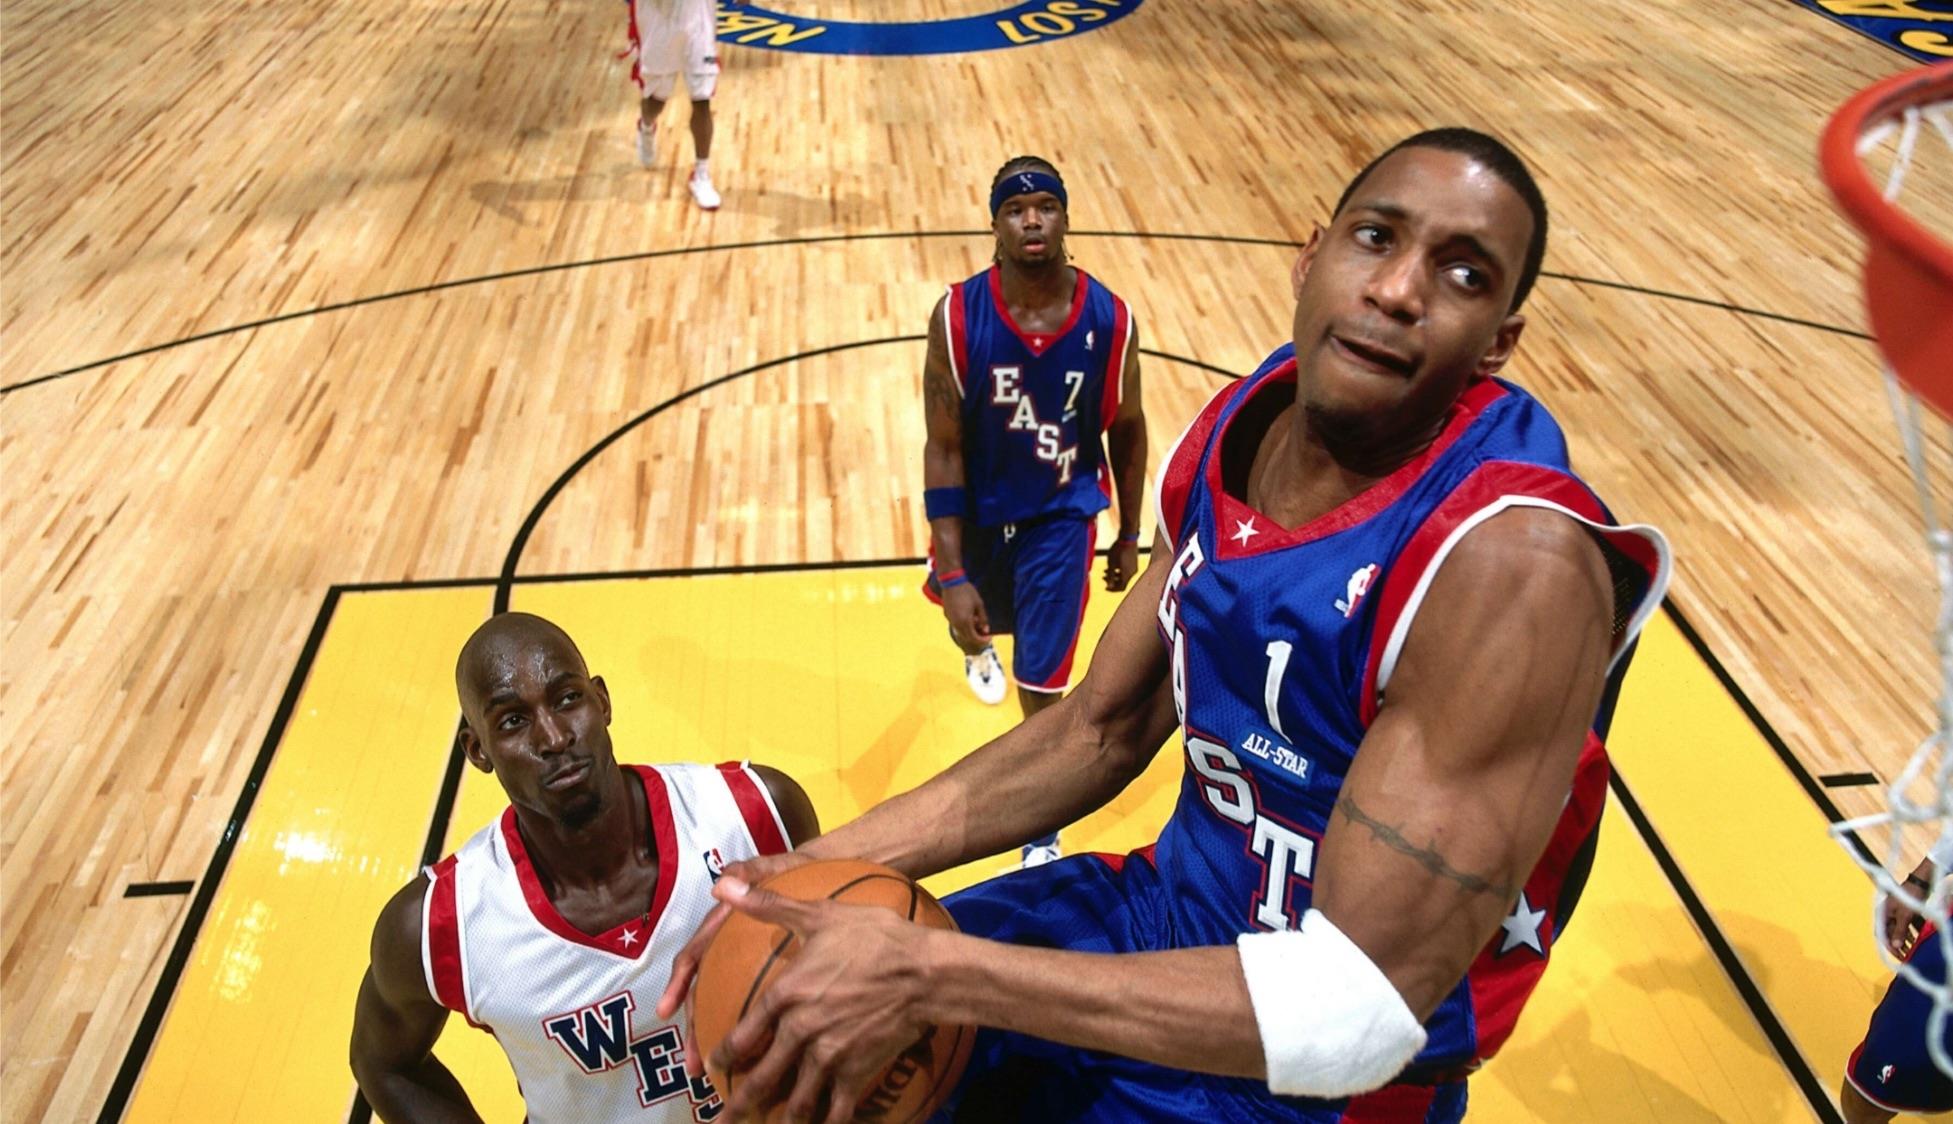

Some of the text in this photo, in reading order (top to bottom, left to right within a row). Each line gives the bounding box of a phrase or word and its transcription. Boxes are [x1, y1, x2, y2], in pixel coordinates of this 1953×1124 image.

[996, 2, 1107, 43] LOS
[991, 366, 1078, 485] EAST
[1064, 371, 1085, 411] 7
[1264, 640, 1293, 745] 1
[1157, 531, 1316, 932] EAST
[1241, 733, 1308, 778] ALL-STAR
